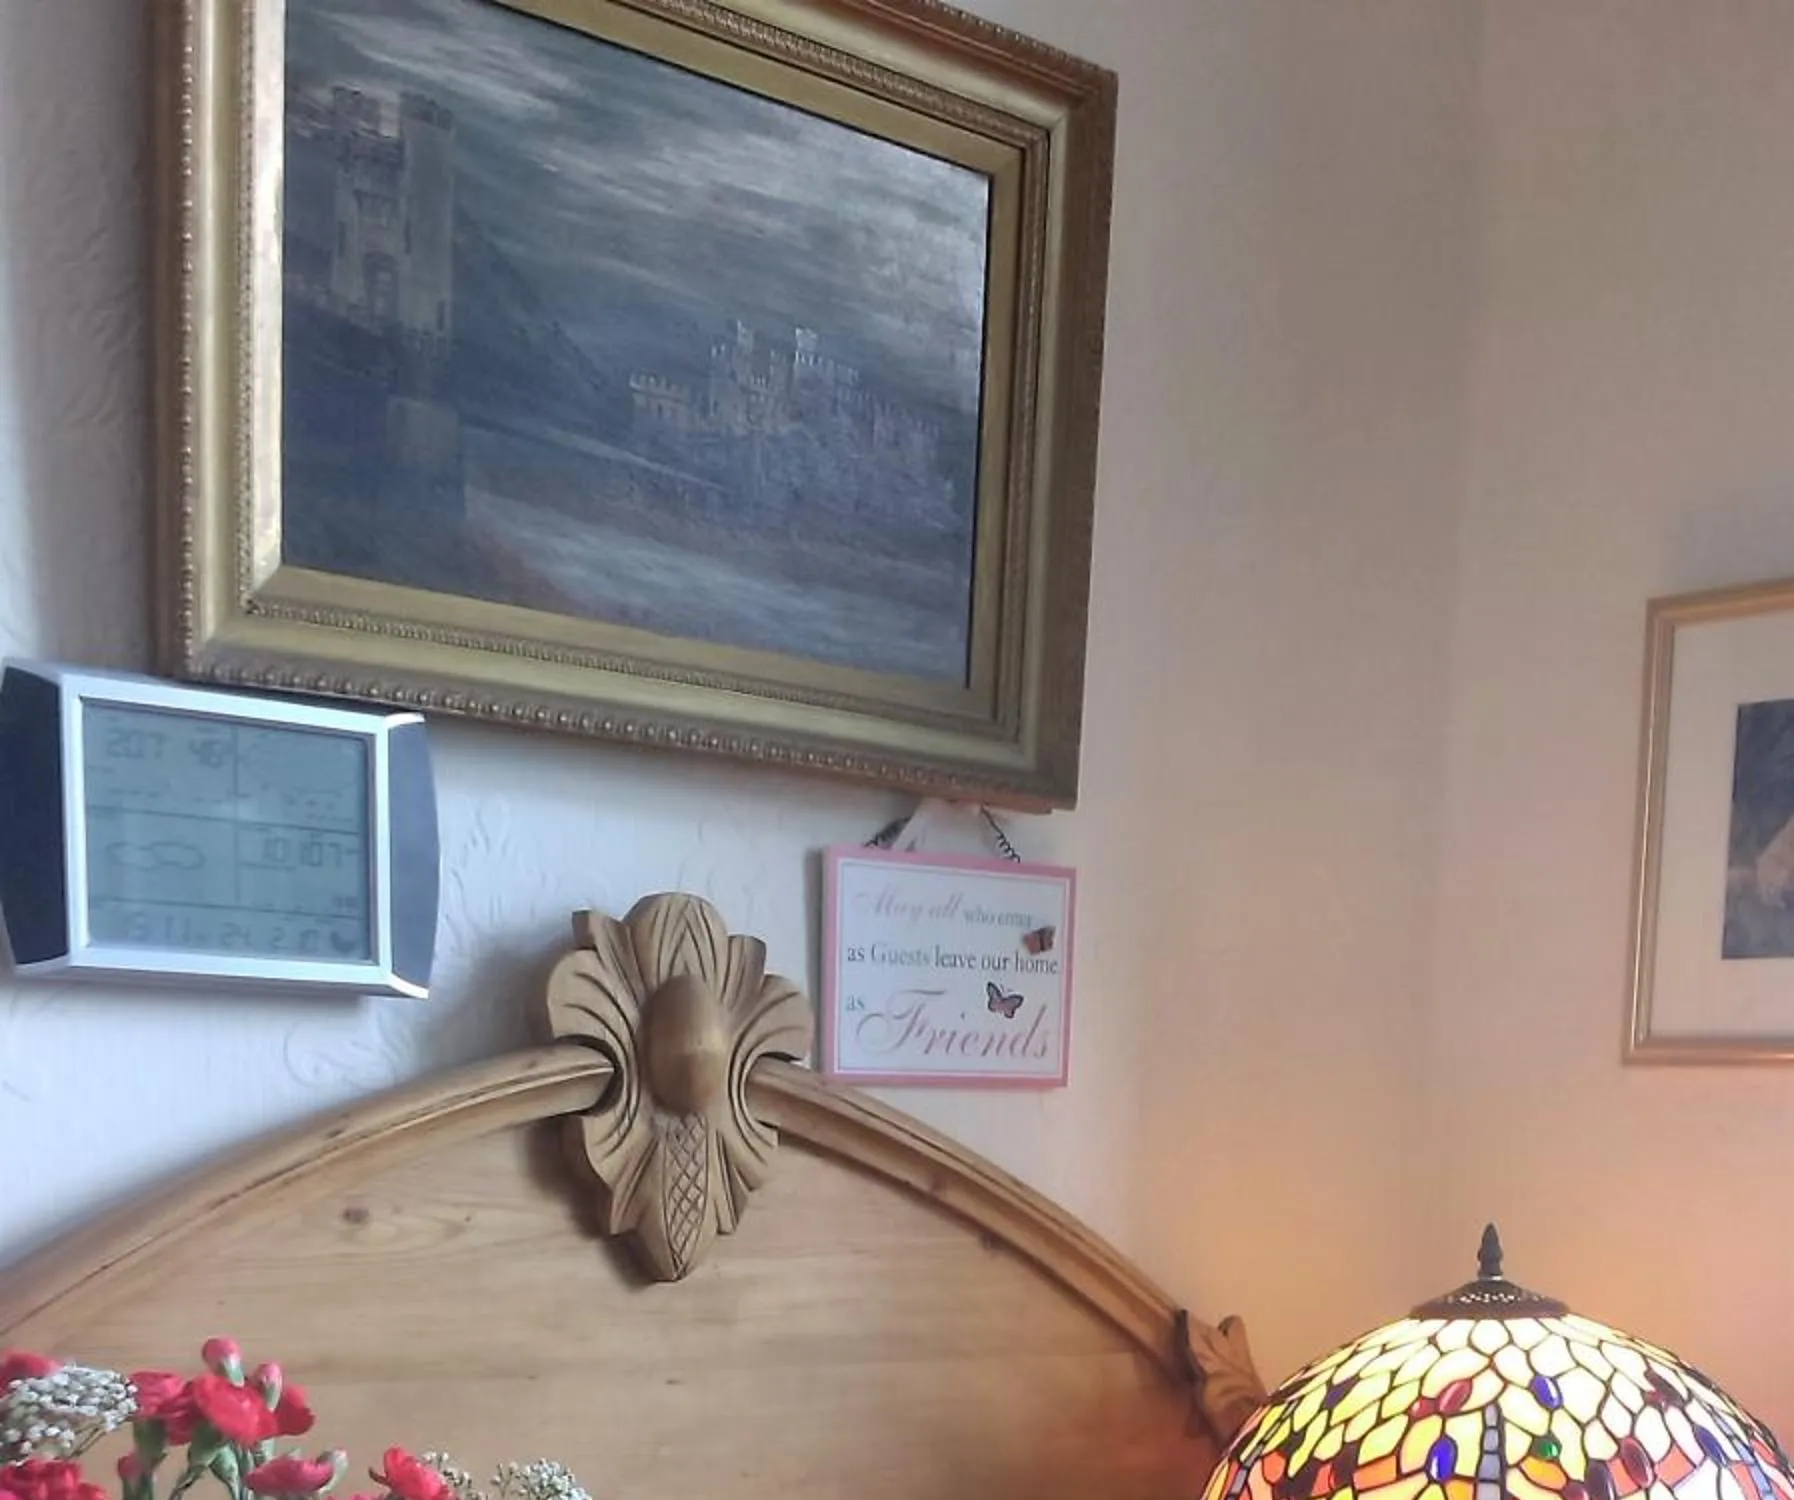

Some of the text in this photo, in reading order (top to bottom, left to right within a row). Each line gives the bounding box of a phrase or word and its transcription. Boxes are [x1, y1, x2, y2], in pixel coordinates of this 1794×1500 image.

[963, 904, 996, 924] who
[847, 943, 1058, 975] as Guests leave our home
[846, 989, 1050, 1060] as Friends
